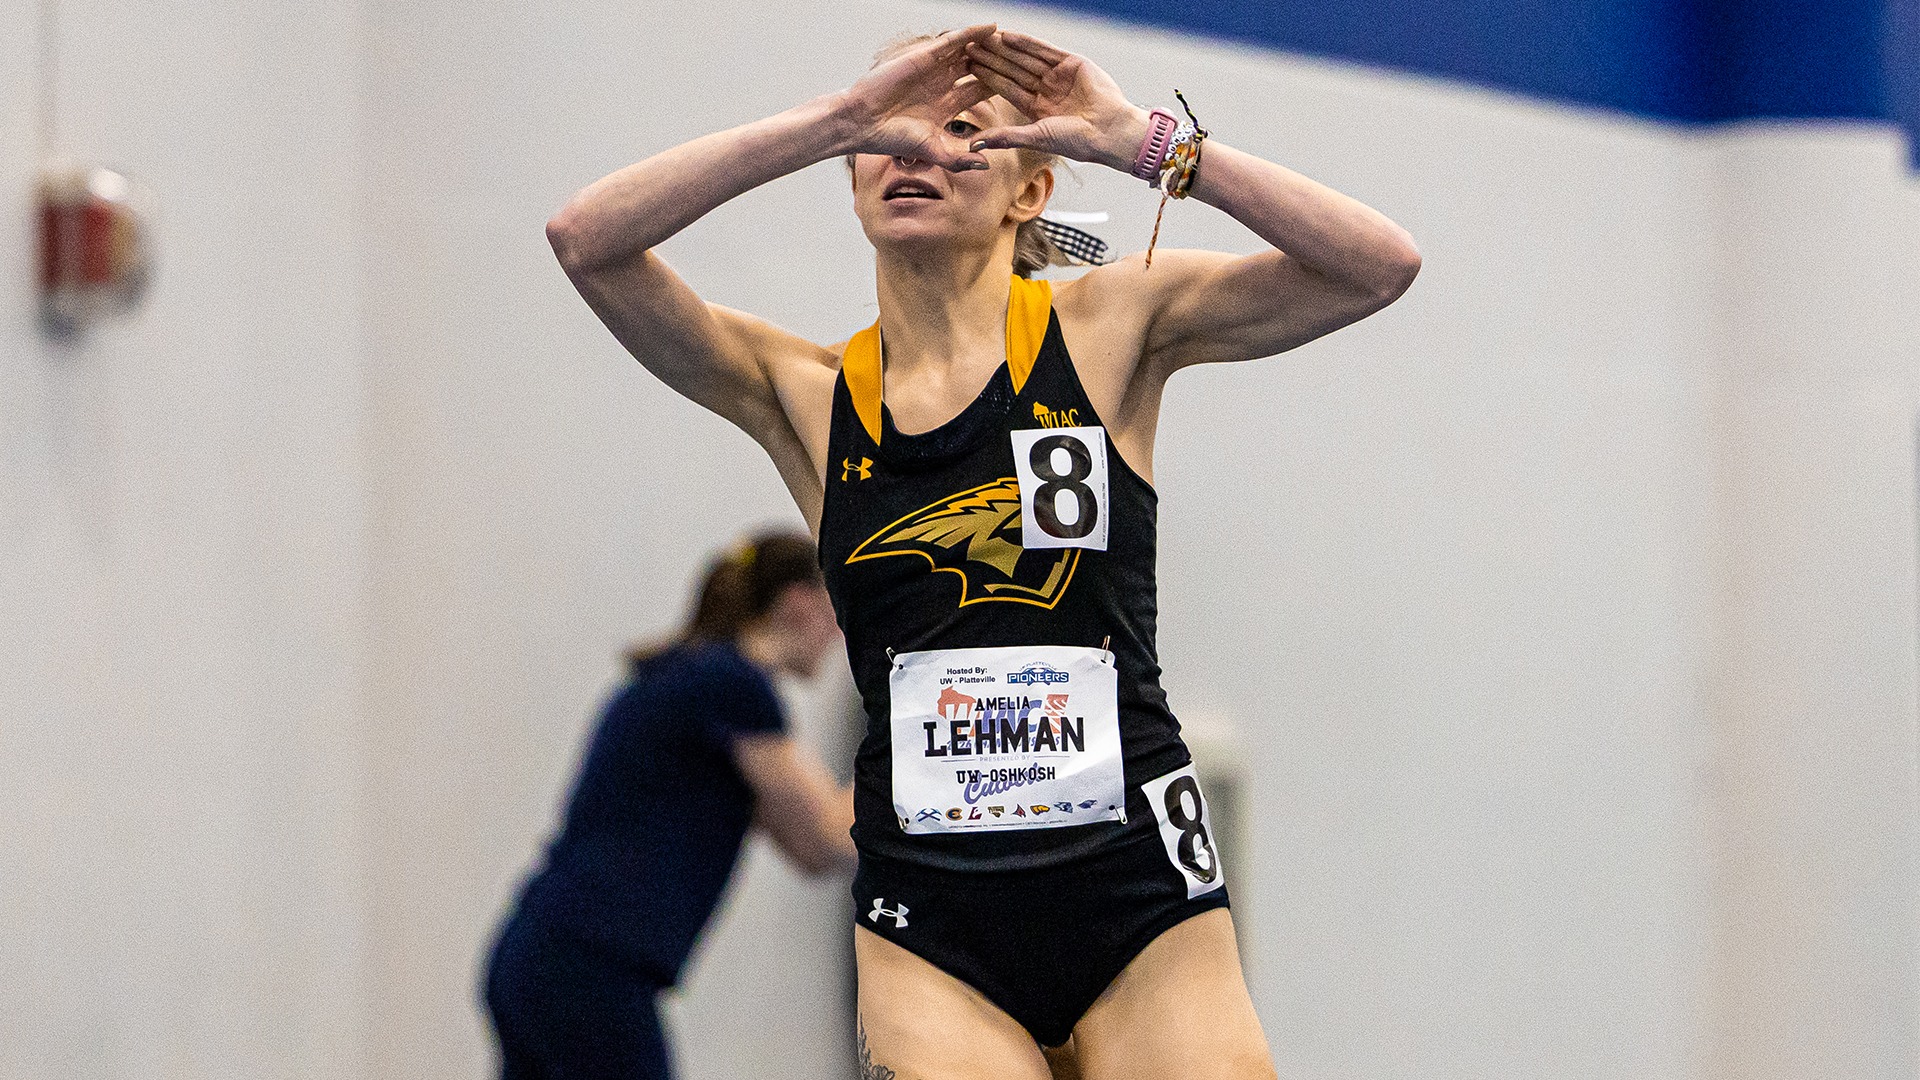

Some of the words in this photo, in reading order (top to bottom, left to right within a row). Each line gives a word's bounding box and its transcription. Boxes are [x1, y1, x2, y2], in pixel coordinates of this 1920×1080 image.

[1034, 408, 1082, 429] WIAC
[1029, 435, 1099, 539] 8
[946, 667, 973, 675] Hosted
[975, 667, 988, 676] By:
[959, 676, 996, 684] Platteville
[1008, 672, 1068, 683] PIONEERS
[974, 695, 1031, 711] AMELIA
[923, 716, 1085, 757] LEHMAN
[955, 766, 1056, 784] UW-OSHKOSH
[1163, 775, 1217, 884] 8
